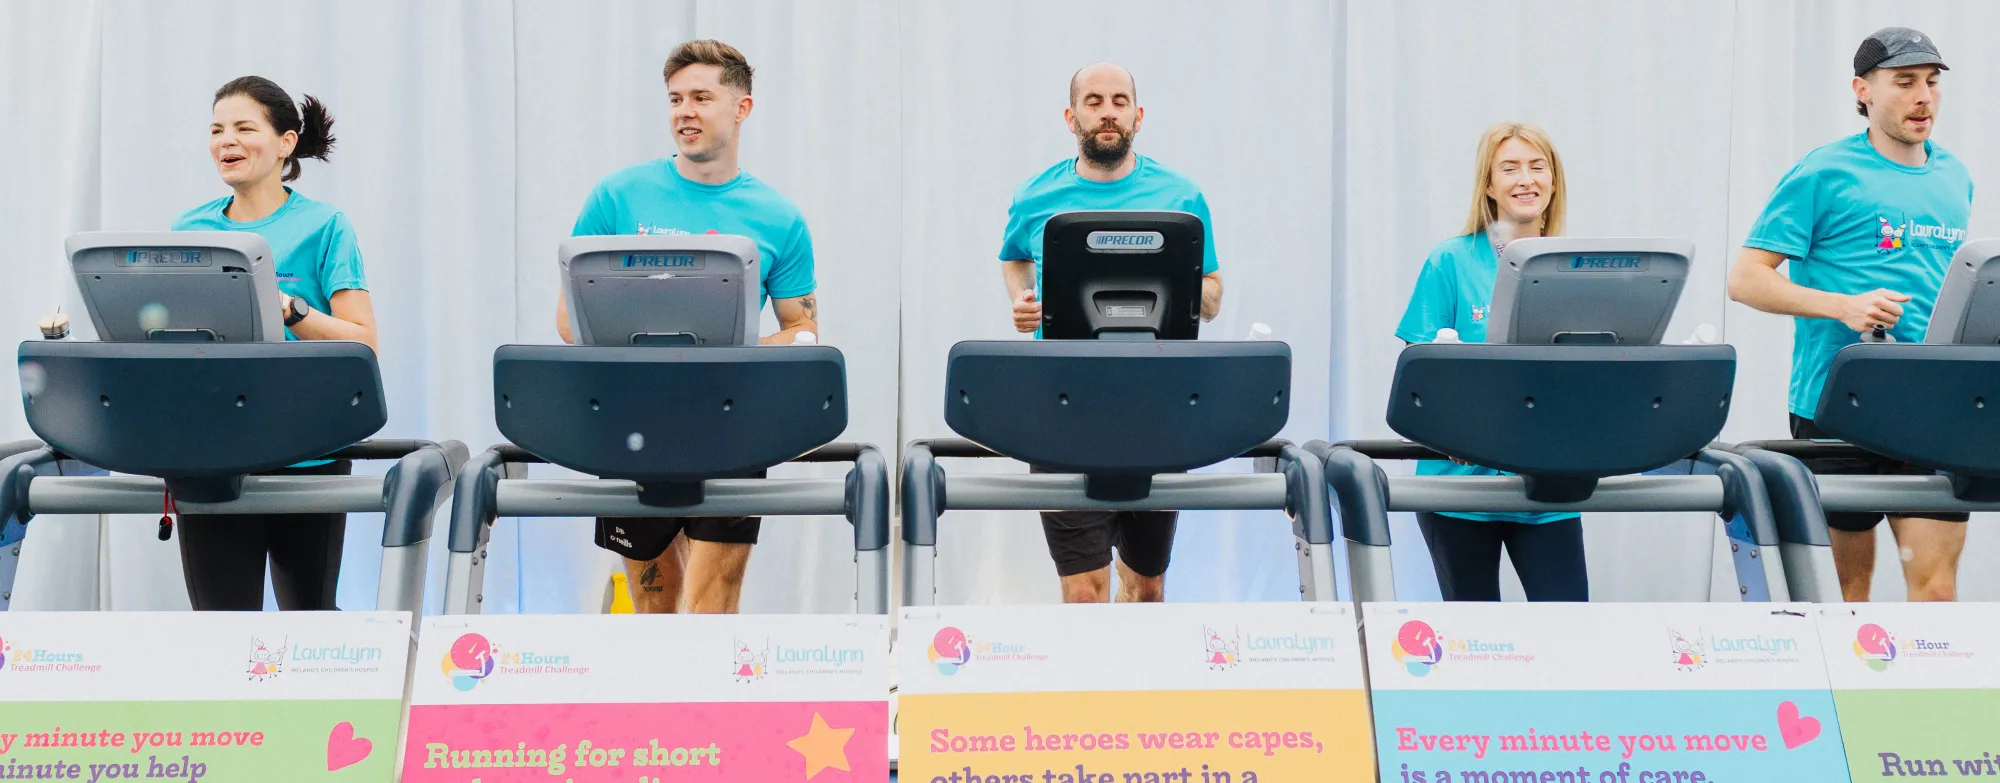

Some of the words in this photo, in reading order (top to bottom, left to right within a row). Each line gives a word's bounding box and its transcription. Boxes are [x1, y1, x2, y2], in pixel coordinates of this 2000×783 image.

[1104, 235, 1154, 245] PRECOR
[632, 254, 695, 267] PRECOR
[1579, 256, 1641, 268] PRECOR
[292, 642, 382, 665] LauraLynn
[1246, 632, 1335, 654] LauraLynn
[1710, 634, 1798, 655] LauraLynn
[776, 644, 864, 667] LauraLynn
[975, 653, 1011, 662] Treadmill
[1011, 653, 1050, 663] Challenge
[1448, 652, 1491, 662] Treadmill
[1492, 653, 1536, 663] Challenge
[10, 663, 54, 673] Treadmill
[55, 663, 102, 674] Challenge
[500, 665, 543, 675] Treadmill
[544, 665, 590, 675] Challenge
[23, 726, 126, 748] minute
[130, 731, 183, 754] you
[189, 731, 265, 747] move
[930, 728, 1016, 753] Some
[1023, 725, 1130, 751] heroes
[1137, 731, 1220, 750] wear
[1228, 731, 1324, 757] capes,
[1395, 727, 1491, 760] Every
[1498, 727, 1612, 752] minute
[1618, 734, 1677, 759] you
[1683, 734, 1768, 752] move
[423, 742, 567, 776] Running
[574, 739, 626, 767] for
[633, 738, 721, 767] short
[1877, 752, 1948, 776] Run
[0, 757, 81, 779] inute
[86, 763, 140, 783] you
[145, 755, 207, 783] help
[1042, 764, 1115, 783] take
[1201, 764, 1231, 783] in
[1400, 763, 1427, 783] is
[1435, 770, 1451, 783] a
[1461, 767, 1590, 783] moment
[1599, 762, 1631, 783] of
